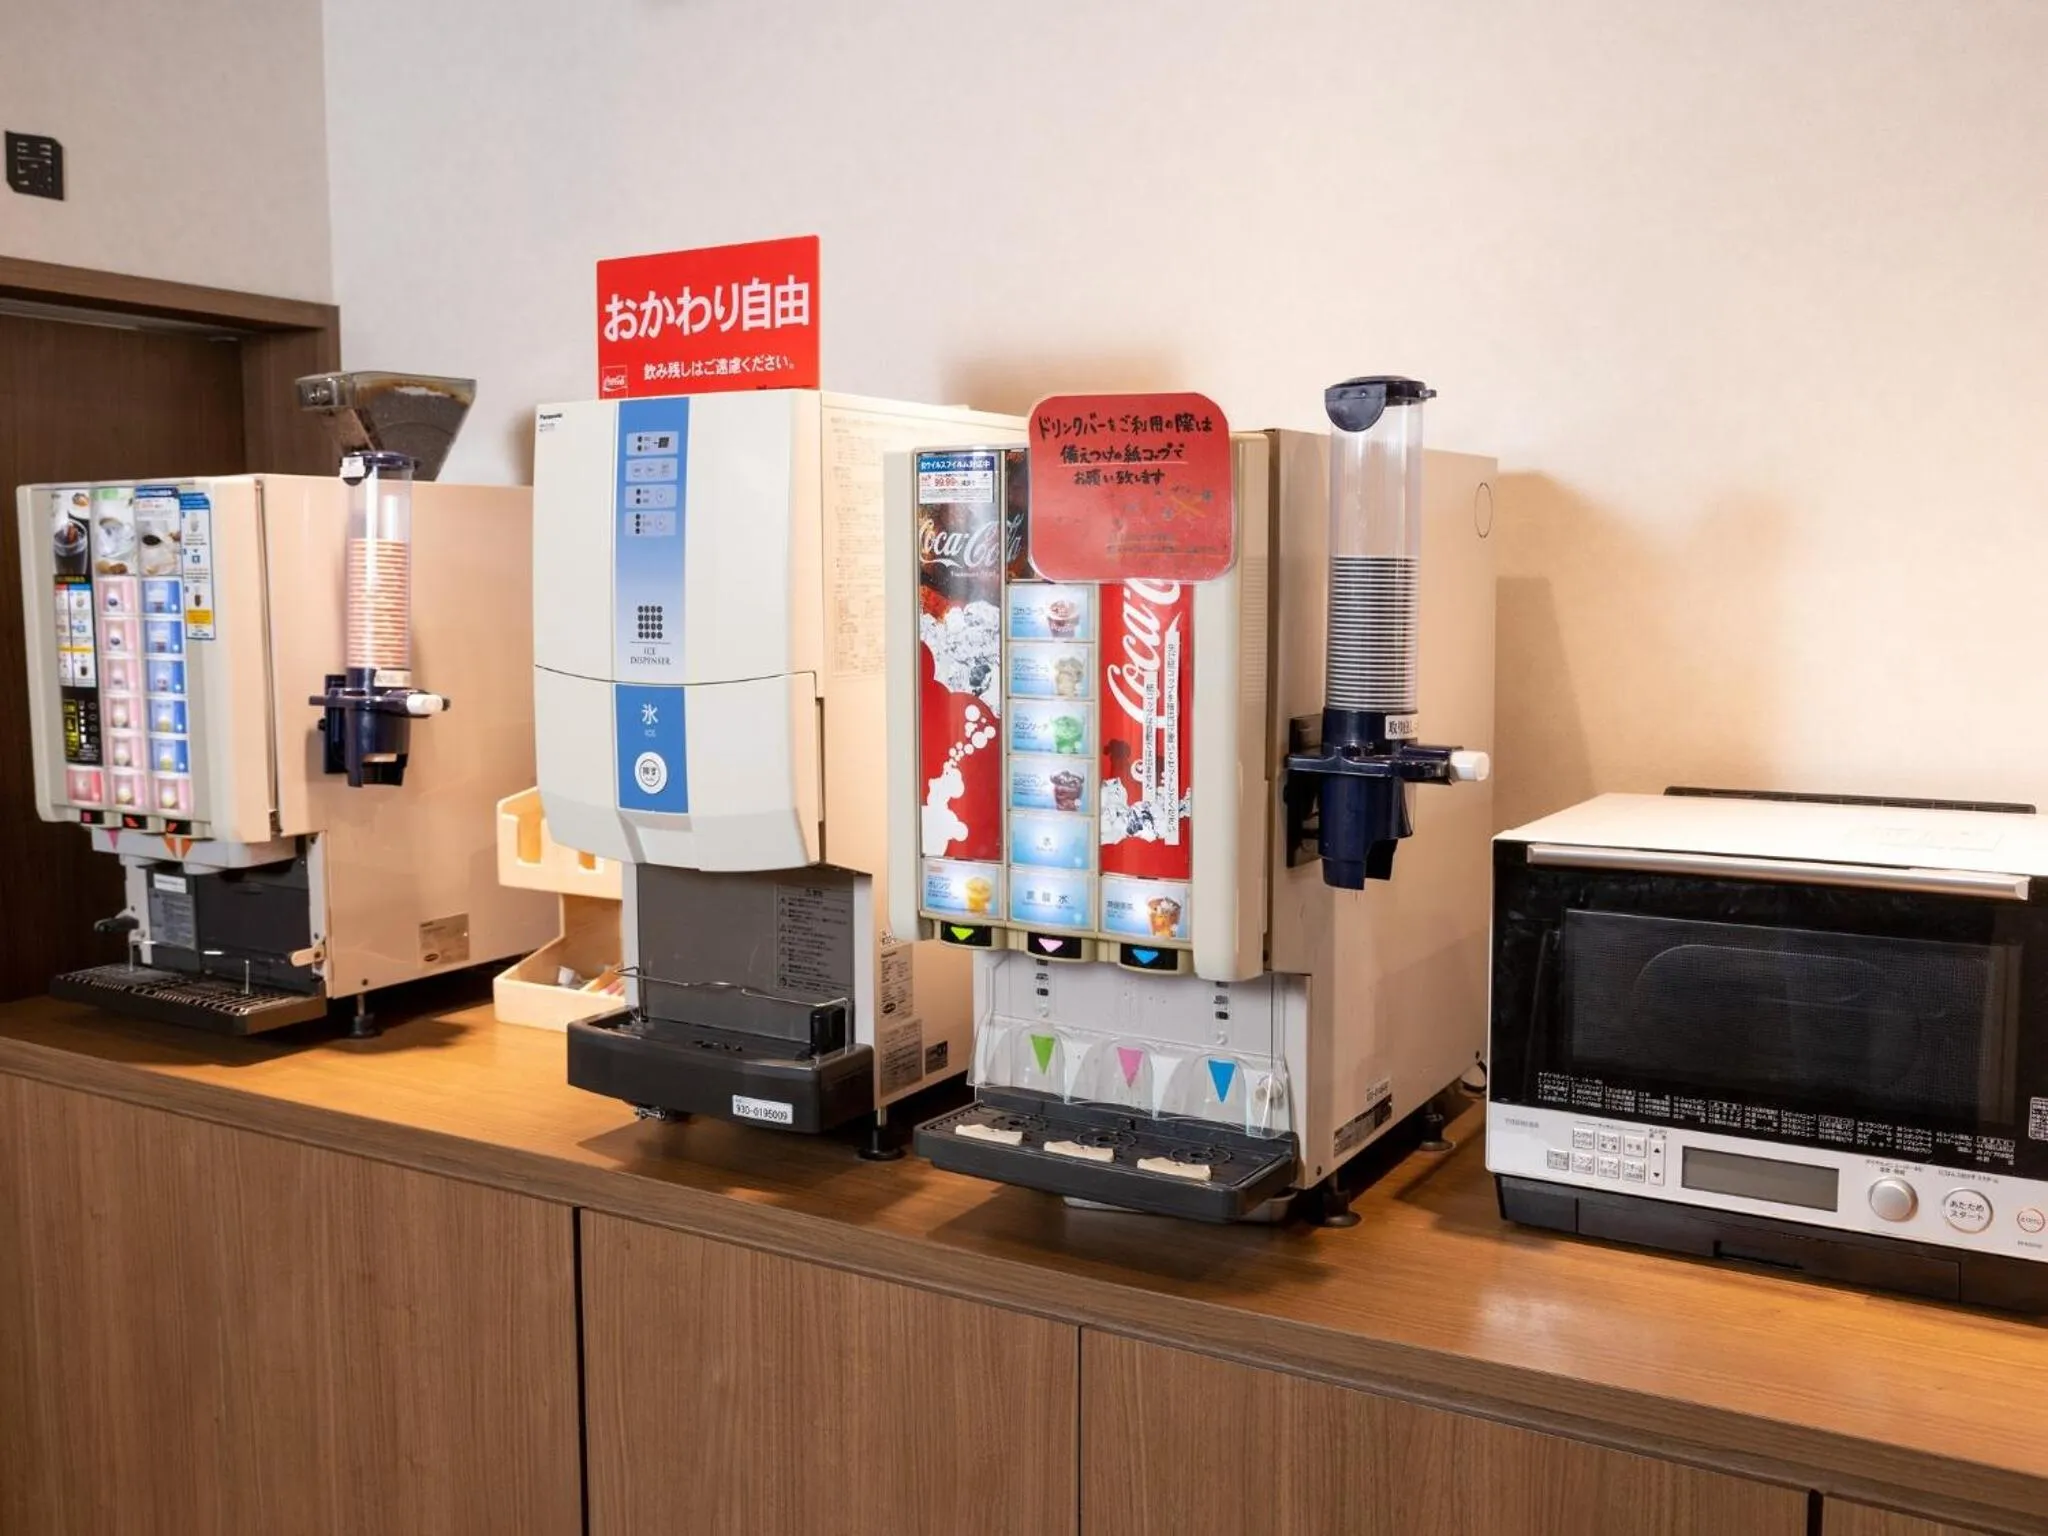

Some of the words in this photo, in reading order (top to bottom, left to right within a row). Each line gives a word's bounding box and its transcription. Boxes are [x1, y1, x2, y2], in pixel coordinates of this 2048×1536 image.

[604, 274, 810, 343] おかわり自由
[643, 355, 795, 381] 飲み残しはご遠慮ください。
[1038, 412, 1213, 441] ドリンクバーをご利用の際は
[1060, 442, 1186, 464] 備えつけの紙コップで
[1073, 467, 1165, 485] お願い致します
[629, 656, 671, 666] DISPENSER
[643, 647, 656, 656] ICE
[641, 703, 659, 725] 氷
[1949, 1200, 1985, 1212] あたため
[1949, 1209, 1985, 1221] スタート
